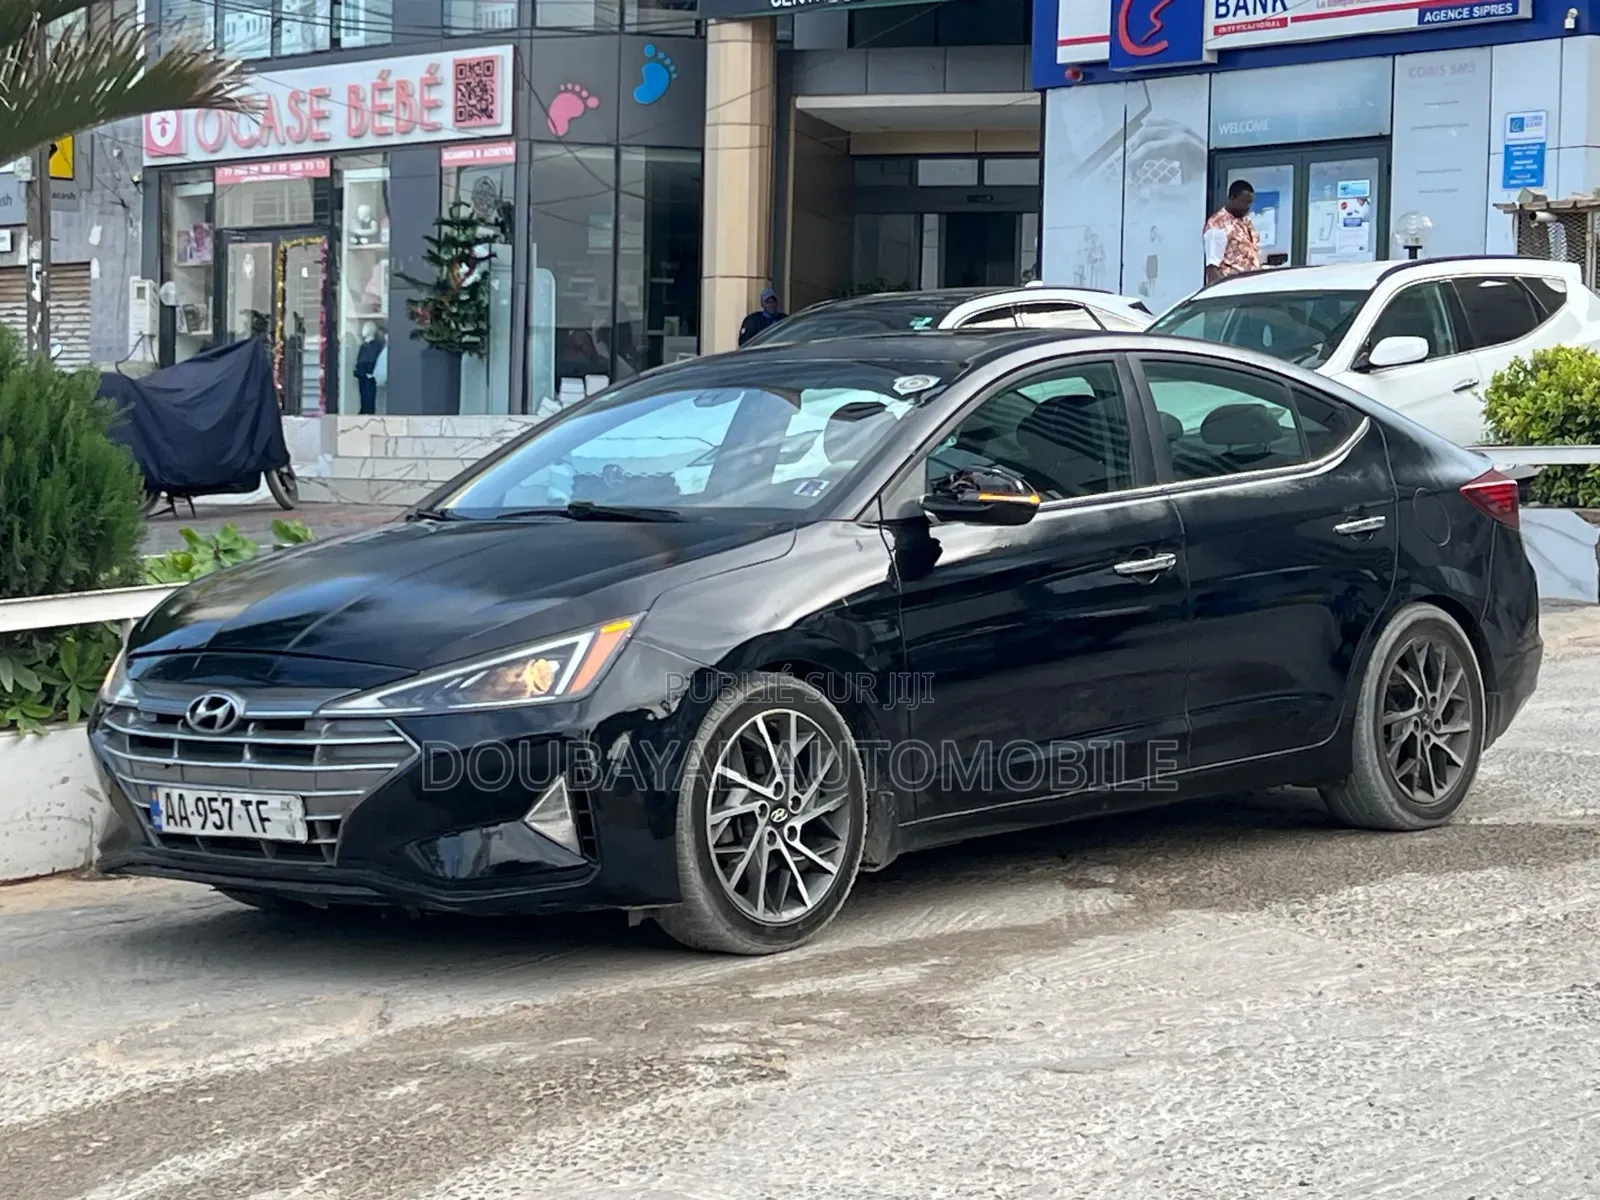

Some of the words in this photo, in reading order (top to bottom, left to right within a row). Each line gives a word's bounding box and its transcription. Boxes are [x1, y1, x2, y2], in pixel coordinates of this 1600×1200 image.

[1424, 7, 1470, 22] AGENCE
[1472, 3, 1513, 18] SIPRES
[194, 86, 331, 154] OCASE
[346, 62, 443, 138] BÉBÉ
[1219, 118, 1269, 135] WELCOME
